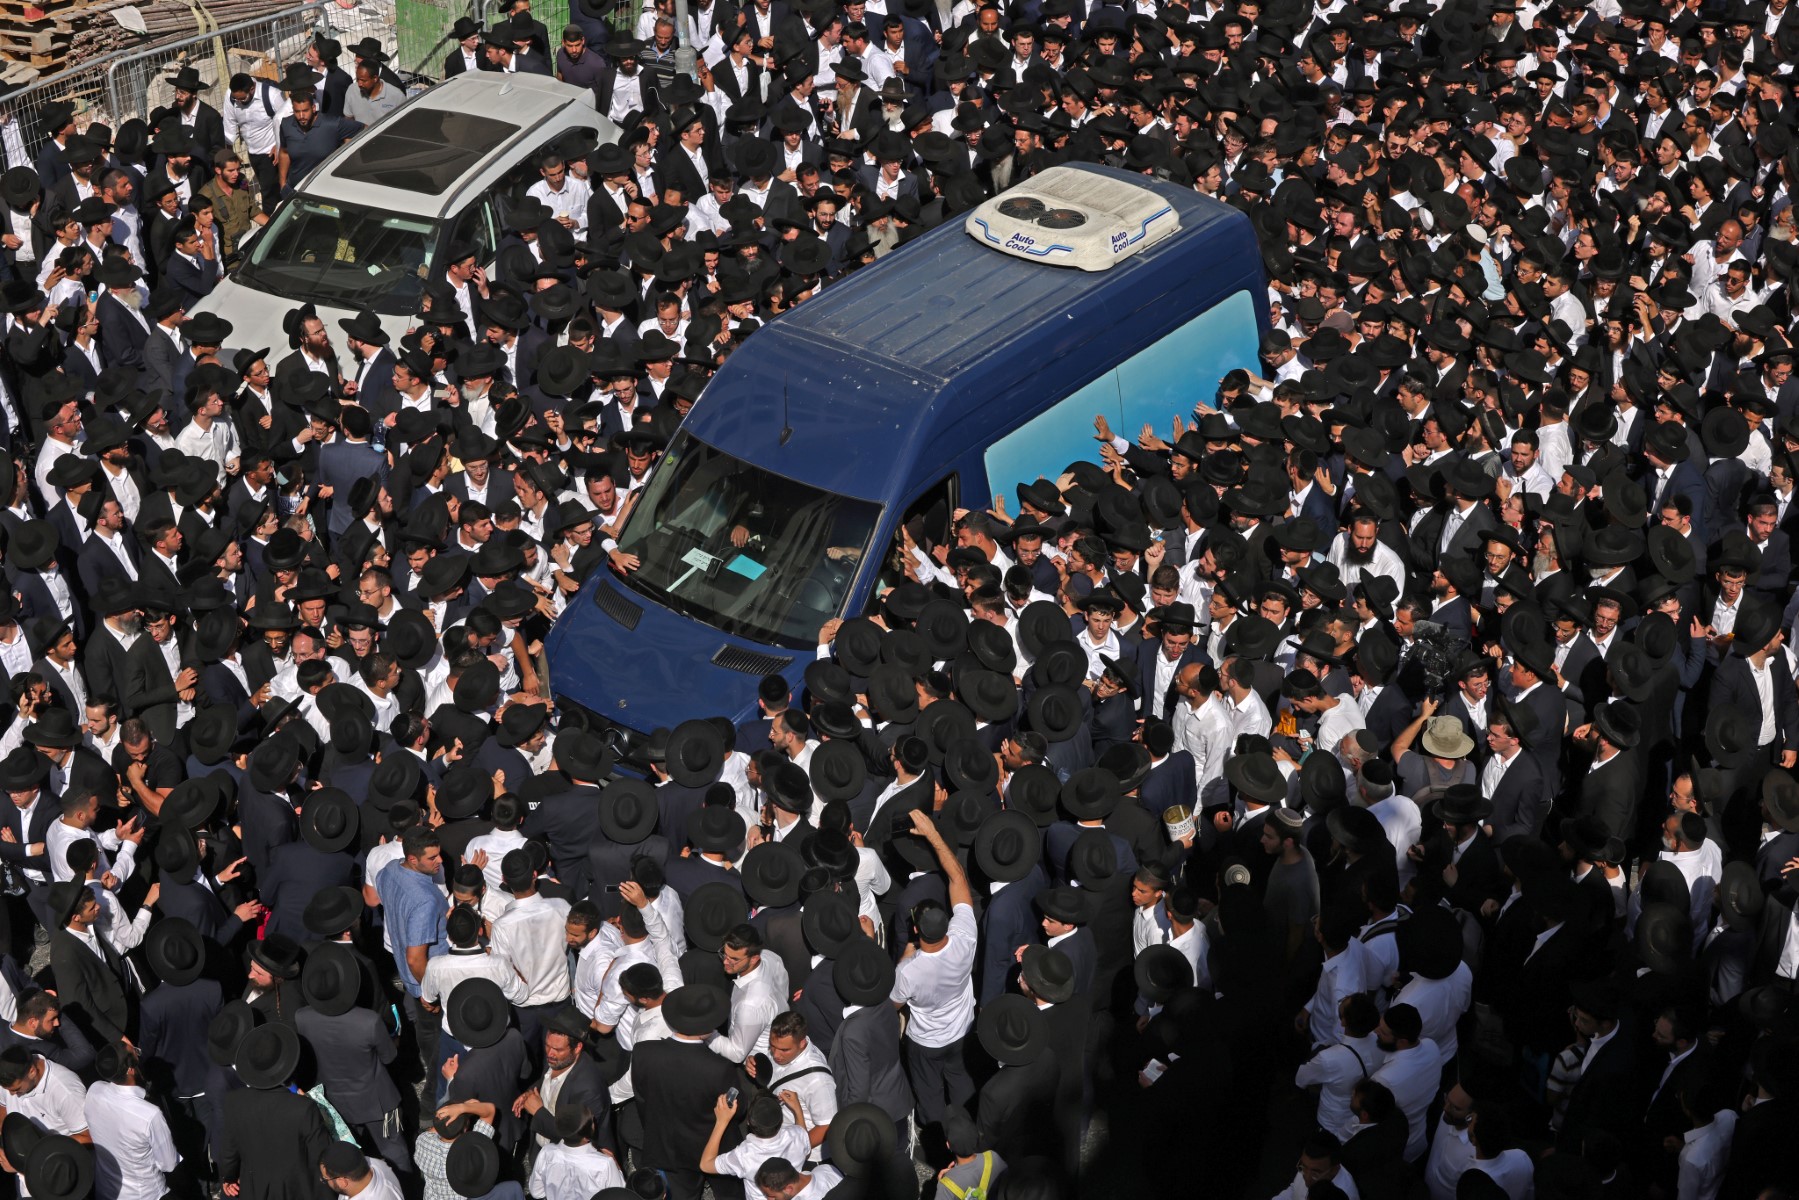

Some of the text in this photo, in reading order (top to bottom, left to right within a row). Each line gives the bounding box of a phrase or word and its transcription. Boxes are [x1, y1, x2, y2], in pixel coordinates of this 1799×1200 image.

[1011, 233, 1035, 245] Auto
[1111, 231, 1127, 244] Auto
[1005, 240, 1030, 252] Cool
[1113, 238, 1129, 254] Cool
